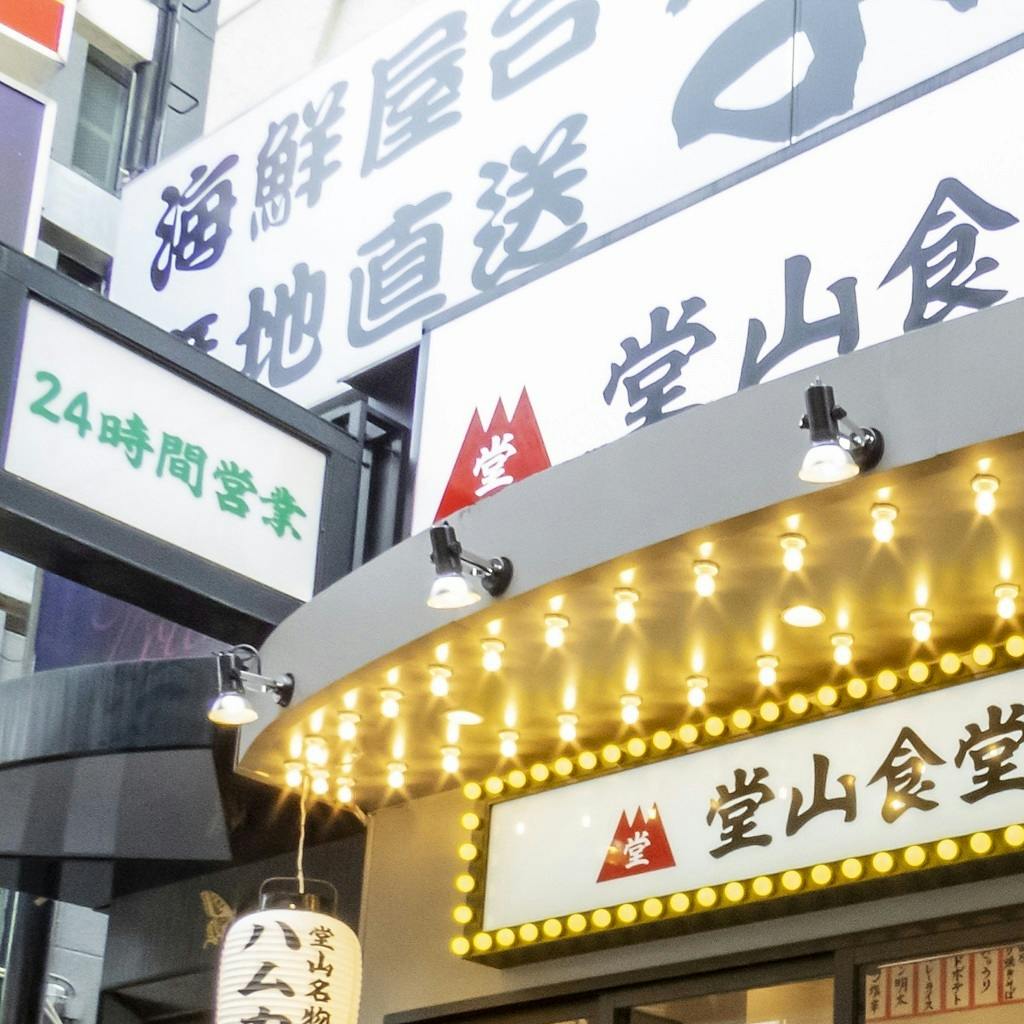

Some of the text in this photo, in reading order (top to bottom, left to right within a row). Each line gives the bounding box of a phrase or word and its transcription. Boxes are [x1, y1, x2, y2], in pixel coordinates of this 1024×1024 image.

[29, 372, 307, 540] 24時間営業
[472, 433, 517, 497] 堂
[623, 830, 652, 869] 堂
